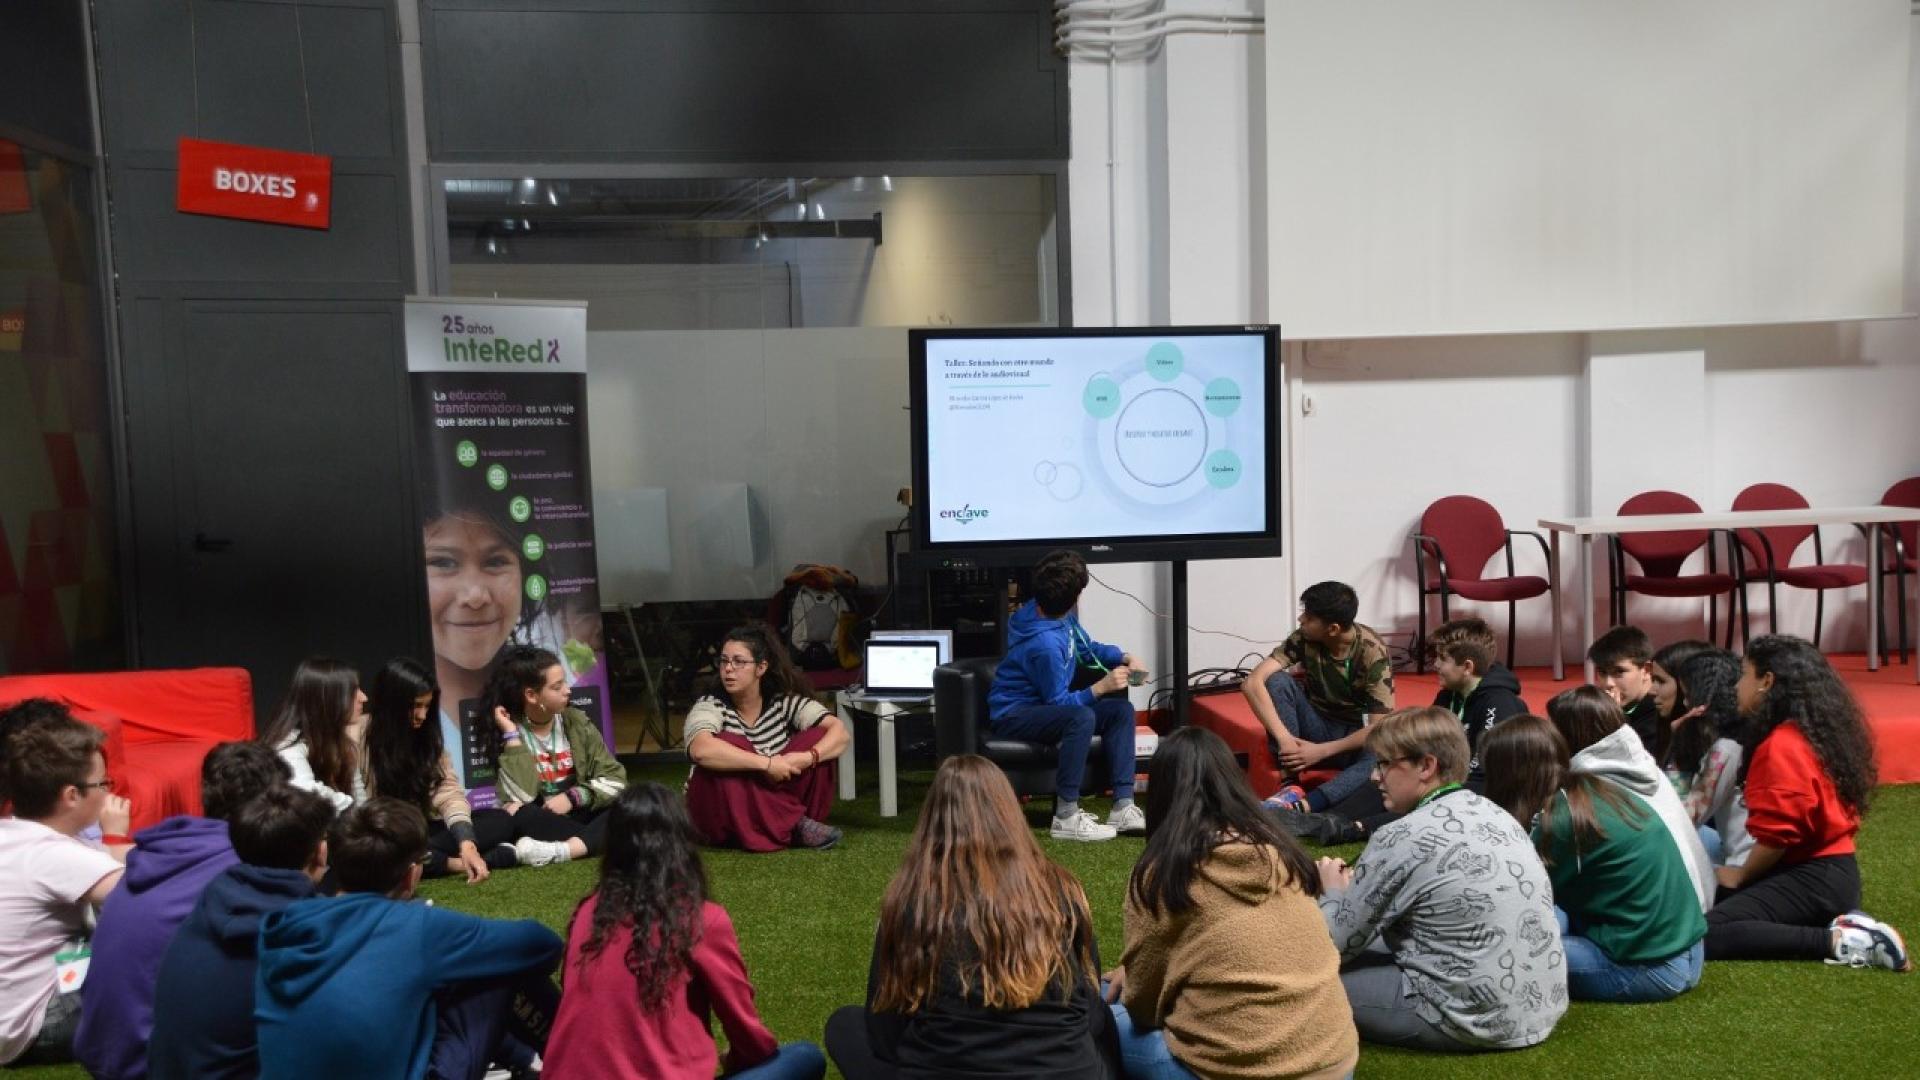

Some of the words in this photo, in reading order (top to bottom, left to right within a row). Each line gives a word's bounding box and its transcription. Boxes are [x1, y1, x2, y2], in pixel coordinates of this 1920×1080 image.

[215, 169, 297, 199] BOXES
[442, 315, 465, 334] 25
[467, 324, 495, 335] años
[443, 337, 544, 363] InteRed
[433, 391, 447, 401] La
[449, 389, 506, 401] educación
[435, 402, 523, 414] transformadora
[539, 405, 551, 413] un
[553, 403, 575, 414] viaje
[436, 417, 455, 429] que
[458, 417, 488, 427] acerca
[489, 418, 496, 426] a
[497, 416, 511, 426] las
[512, 416, 554, 428] personas
